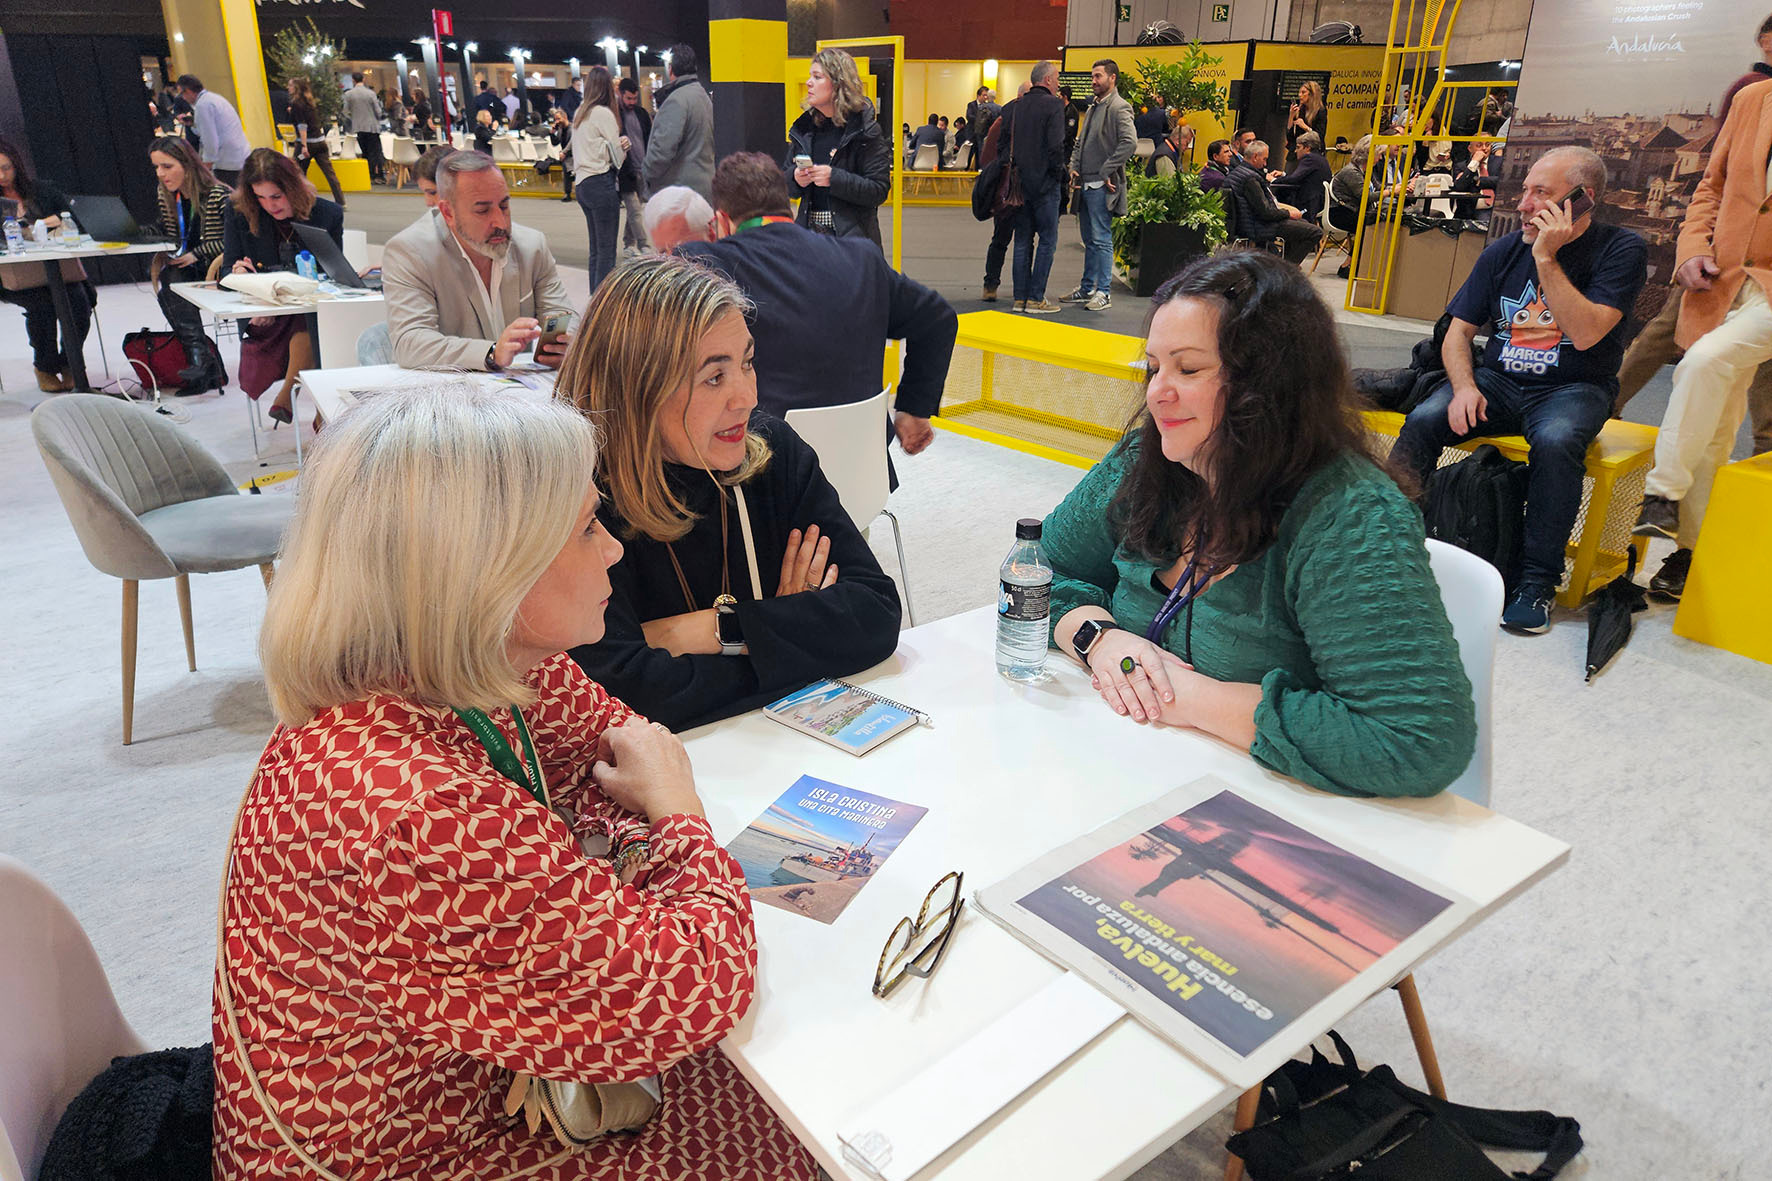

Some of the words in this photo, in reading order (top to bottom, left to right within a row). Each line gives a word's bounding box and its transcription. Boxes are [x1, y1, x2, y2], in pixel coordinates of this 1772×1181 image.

[1606, 32, 1686, 55] Andalucía
[1333, 80, 1392, 95] ACOMPAÑR
[1336, 98, 1345, 109] el
[1502, 346, 1558, 364] MARCO
[1503, 358, 1546, 375] TOPO
[1062, 884, 1102, 906] por
[1119, 900, 1179, 938] tierra
[1095, 903, 1189, 963] andaluza
[1173, 935, 1196, 947] y
[1095, 918, 1204, 1001] Huelva,
[1188, 945, 1239, 977] mar
[1185, 959, 1274, 1021] esencia
